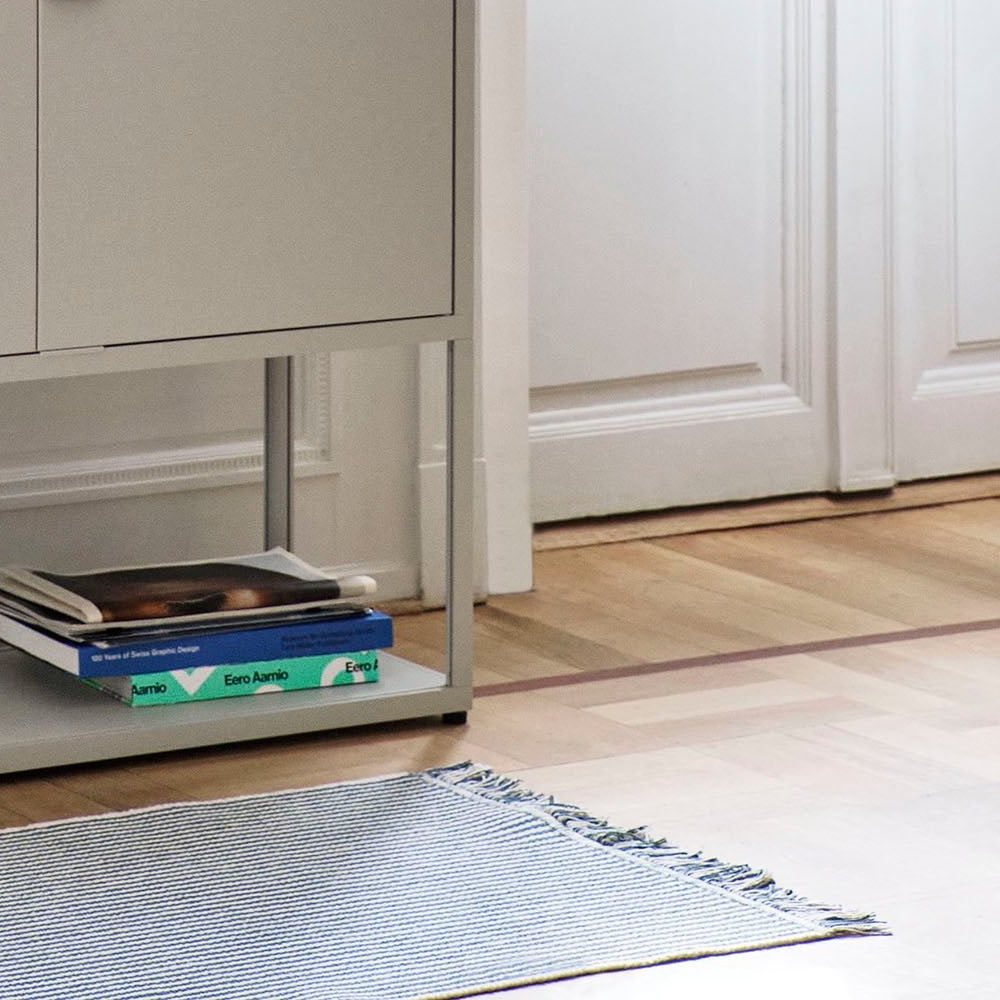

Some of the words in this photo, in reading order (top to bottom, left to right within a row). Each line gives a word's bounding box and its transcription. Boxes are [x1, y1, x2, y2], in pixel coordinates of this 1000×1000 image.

[91, 654, 103, 662] 100
[177, 646, 200, 654] Design
[345, 661, 371, 674] Eero
[224, 673, 251, 686] Eero
[252, 668, 289, 683] Aarnio
[132, 682, 167, 696] Aarnio
